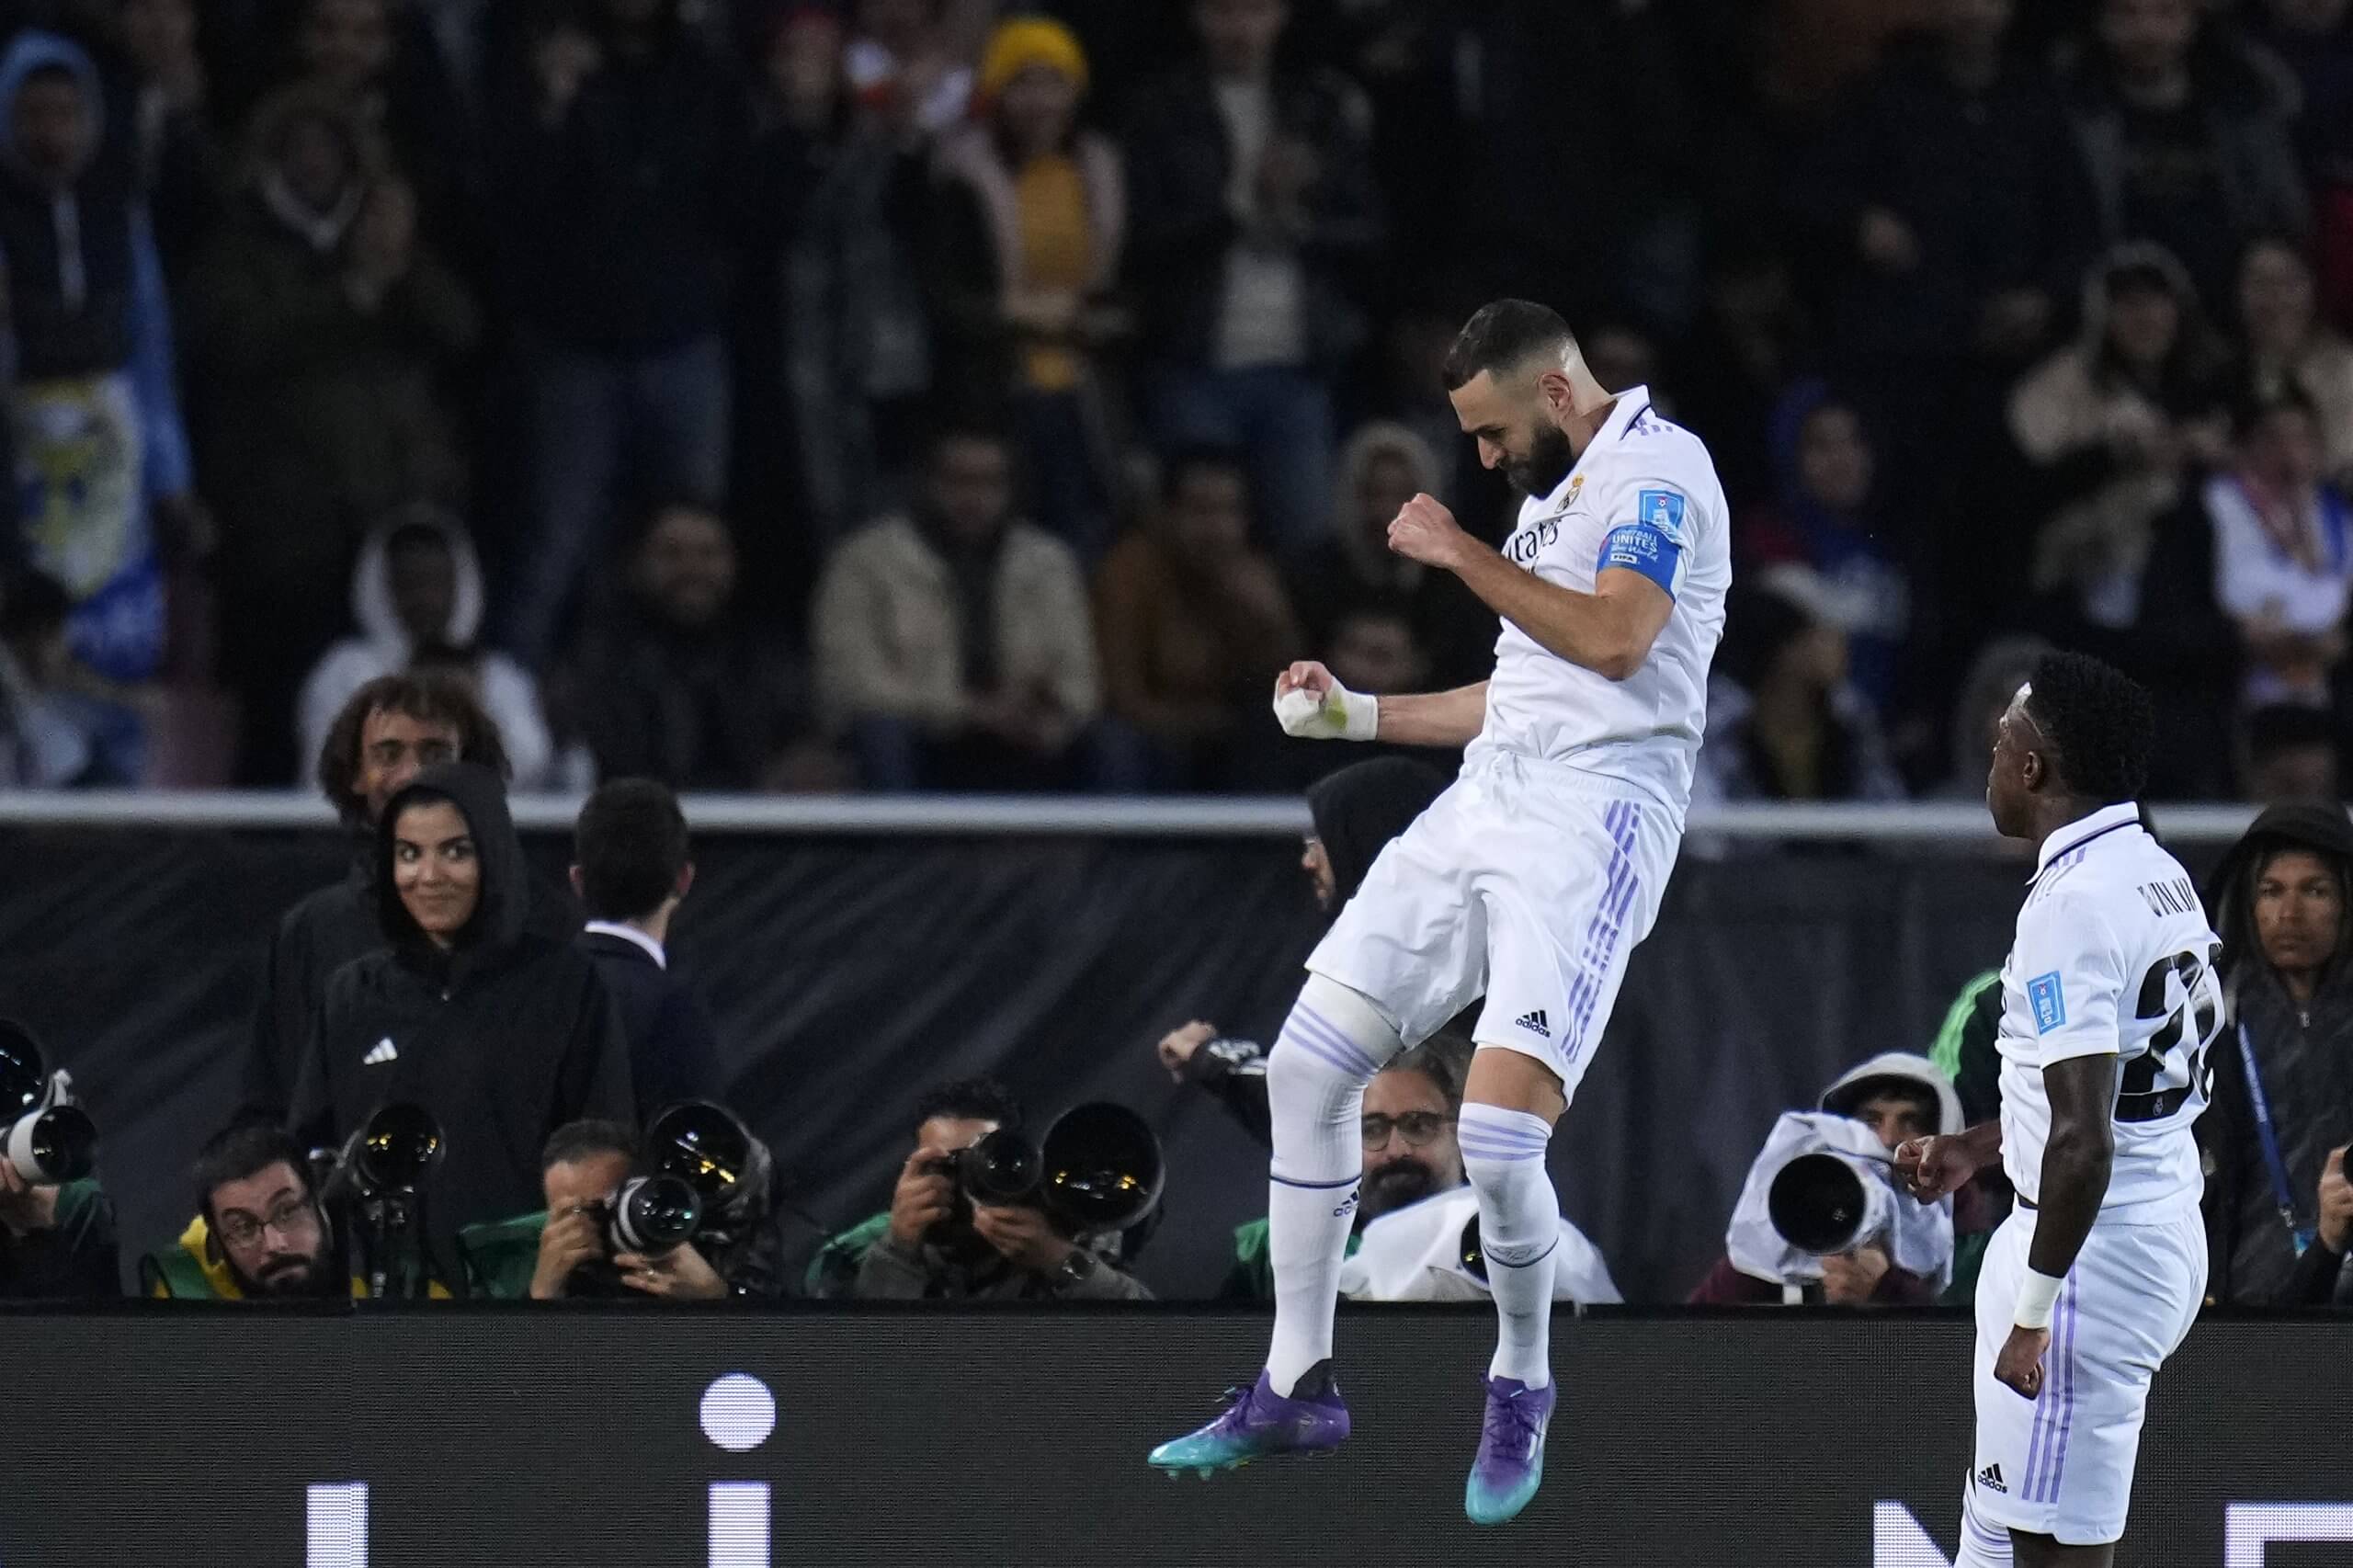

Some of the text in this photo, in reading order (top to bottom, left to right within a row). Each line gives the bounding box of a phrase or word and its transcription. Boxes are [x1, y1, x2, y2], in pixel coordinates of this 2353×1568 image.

[1612, 534, 1658, 553] UNITES
[1515, 1017, 1552, 1039] adidas
[1977, 1474, 2008, 1494] adidas
